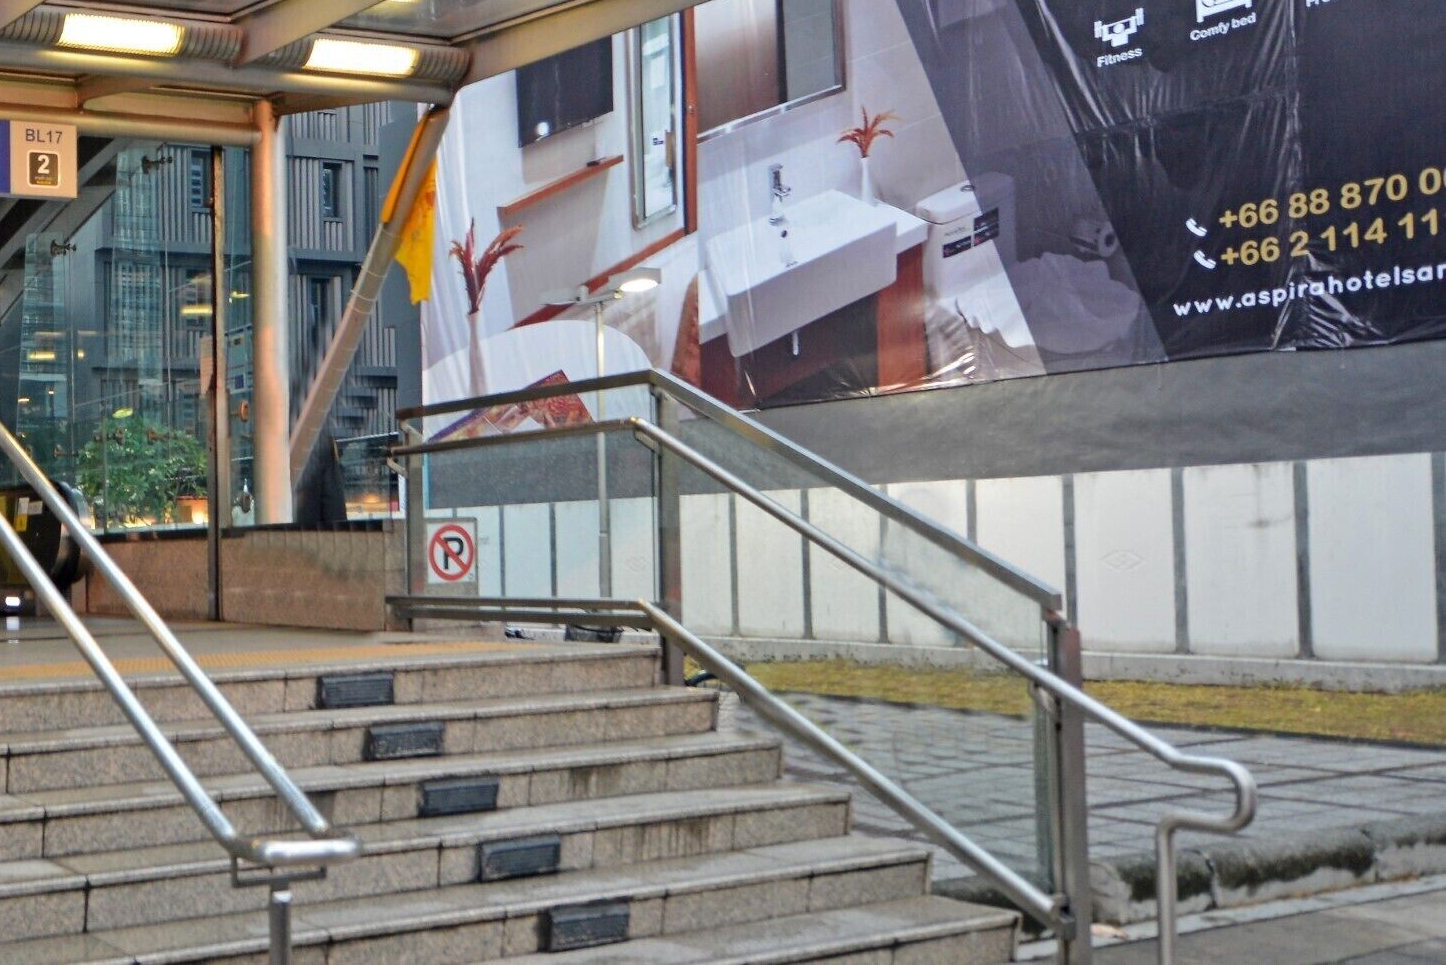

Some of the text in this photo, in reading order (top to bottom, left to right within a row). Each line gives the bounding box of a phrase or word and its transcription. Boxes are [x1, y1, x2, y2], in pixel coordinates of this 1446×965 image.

[1189, 11, 1257, 41] Comfy bed
[1097, 47, 1143, 67] Fitness
[25, 128, 63, 144] BL17
[37, 154, 50, 175] 2
[1219, 198, 1279, 229] +66
[1288, 187, 1331, 219] 88
[1340, 173, 1408, 209] 870
[1220, 236, 1281, 265] +66
[1289, 230, 1310, 257] 2
[1321, 217, 1387, 252] 114
